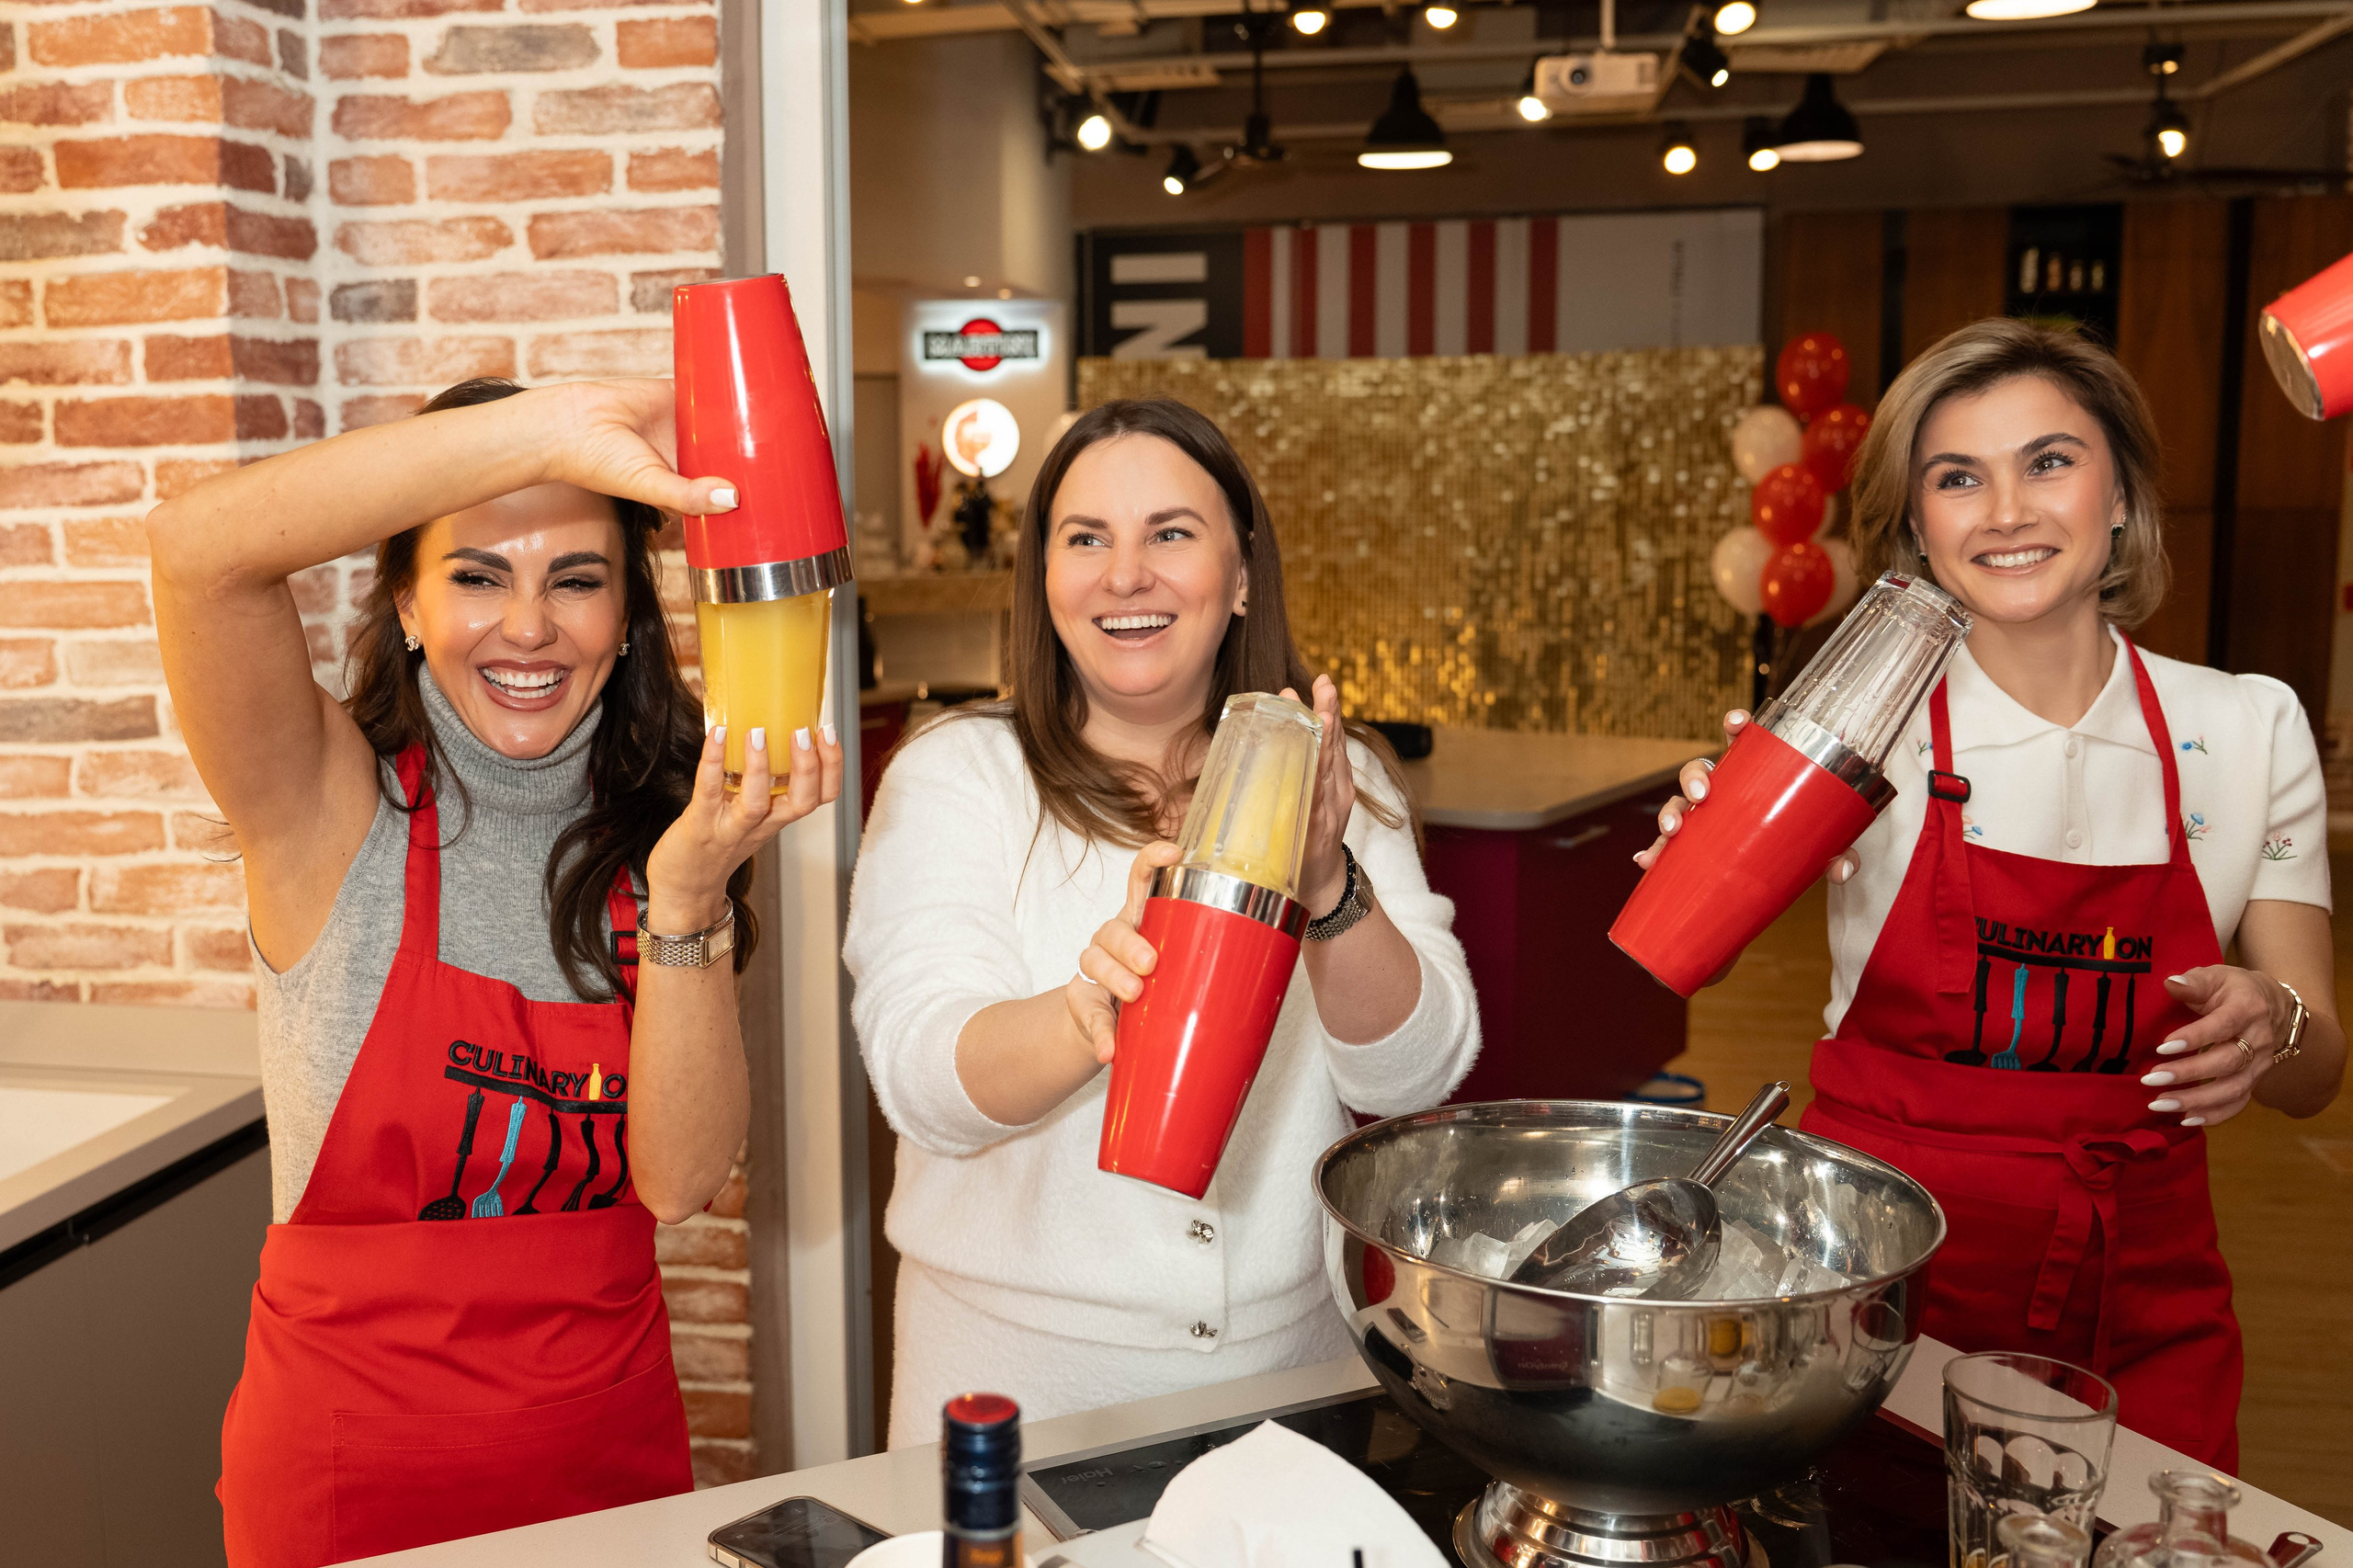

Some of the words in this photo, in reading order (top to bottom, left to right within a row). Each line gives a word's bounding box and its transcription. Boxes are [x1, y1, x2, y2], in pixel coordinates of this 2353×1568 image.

[1975, 916, 2104, 957] ULINARY
[2116, 936, 2153, 960] ON
[449, 1040, 589, 1097] CULINARY
[602, 1074, 629, 1098] O
[1061, 1468, 1114, 1484] Haier
